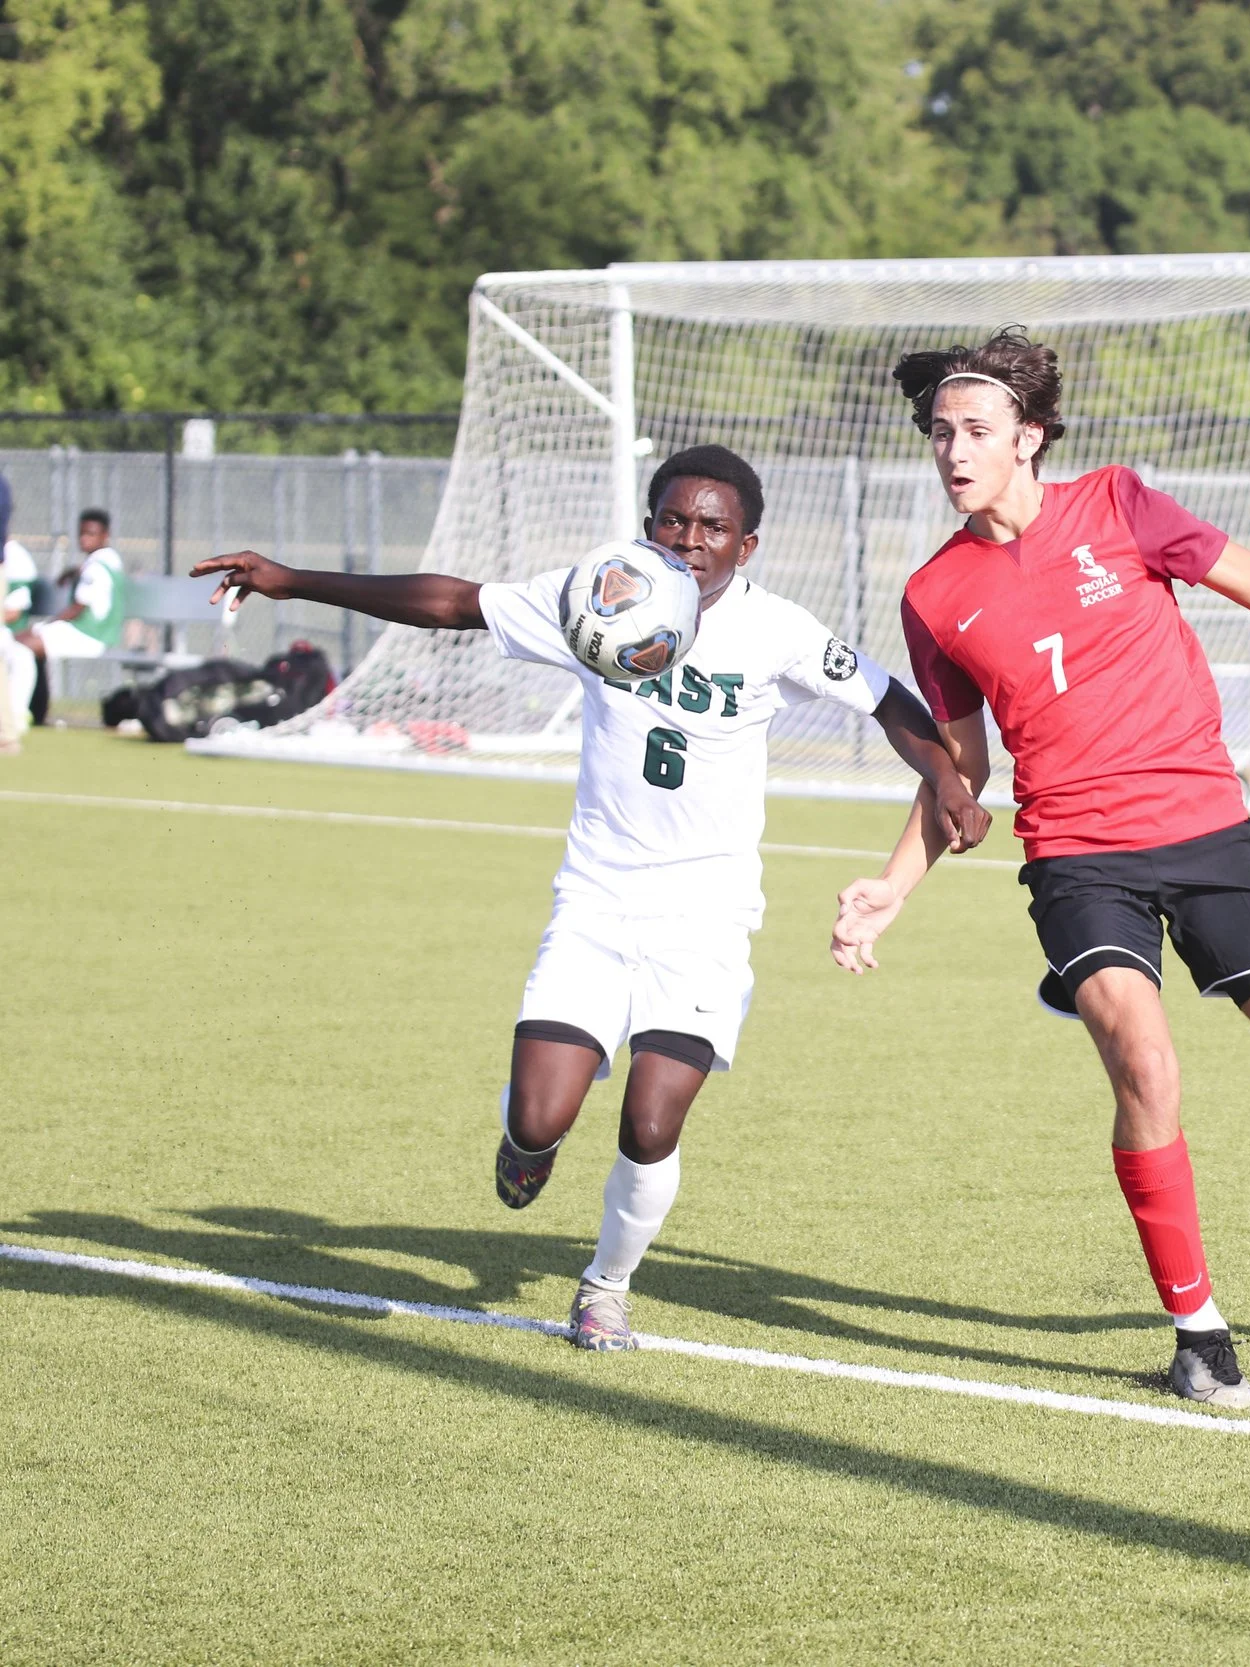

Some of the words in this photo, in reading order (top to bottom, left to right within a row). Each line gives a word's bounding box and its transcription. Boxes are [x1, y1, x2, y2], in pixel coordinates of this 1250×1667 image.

[1076, 572, 1118, 596] TROJAN
[1080, 584, 1123, 607] SOCCER
[587, 631, 604, 664] NCAA
[1033, 632, 1068, 694] 7
[643, 726, 687, 790] 6
